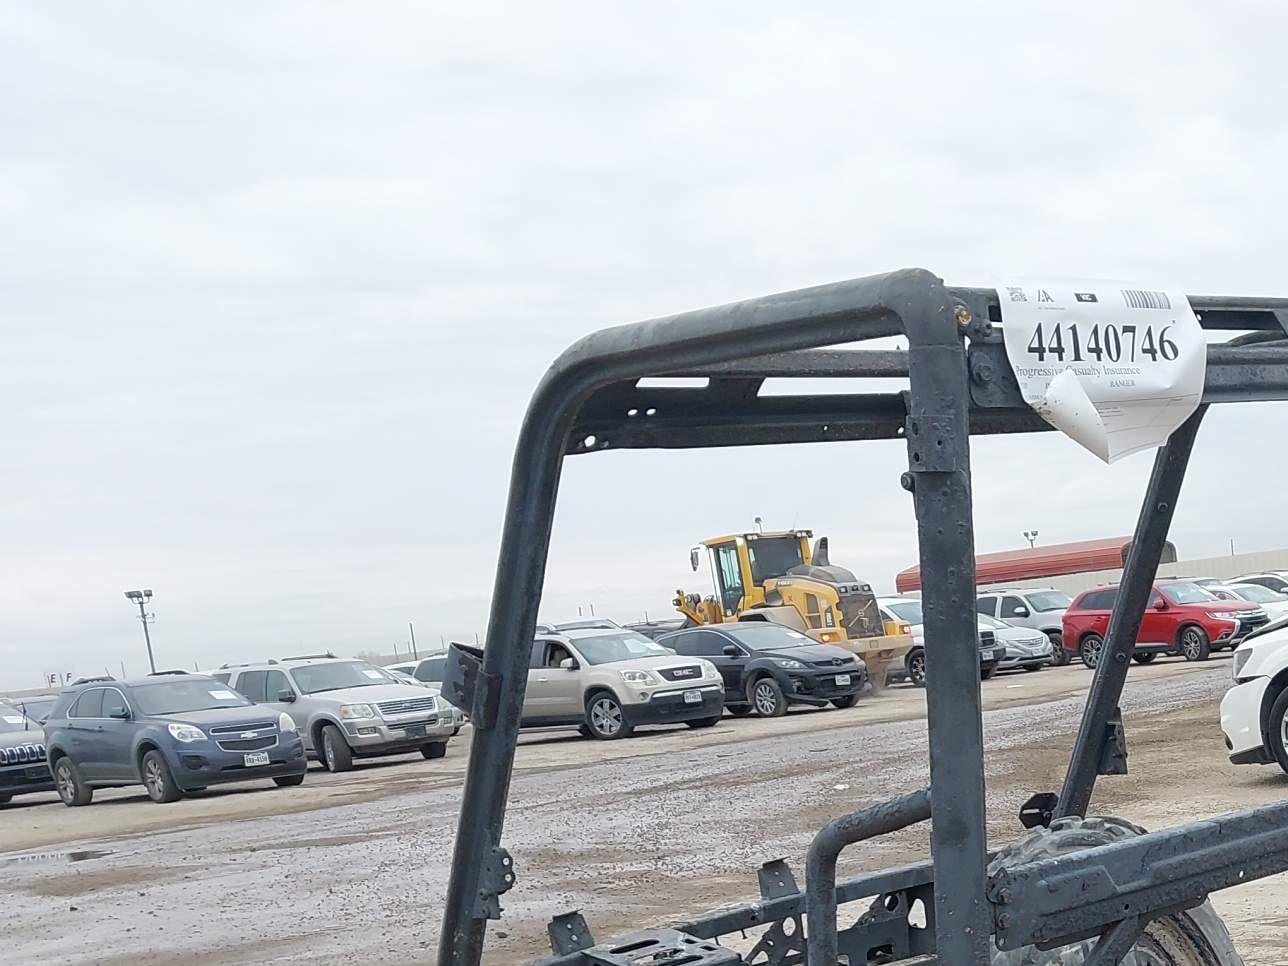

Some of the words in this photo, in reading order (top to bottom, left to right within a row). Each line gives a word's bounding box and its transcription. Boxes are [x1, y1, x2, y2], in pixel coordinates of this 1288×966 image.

[1027, 322, 1179, 363] 44140746
[1103, 365, 1141, 376] Insurance
[51, 673, 56, 683] E
[66, 672, 72, 682] F
